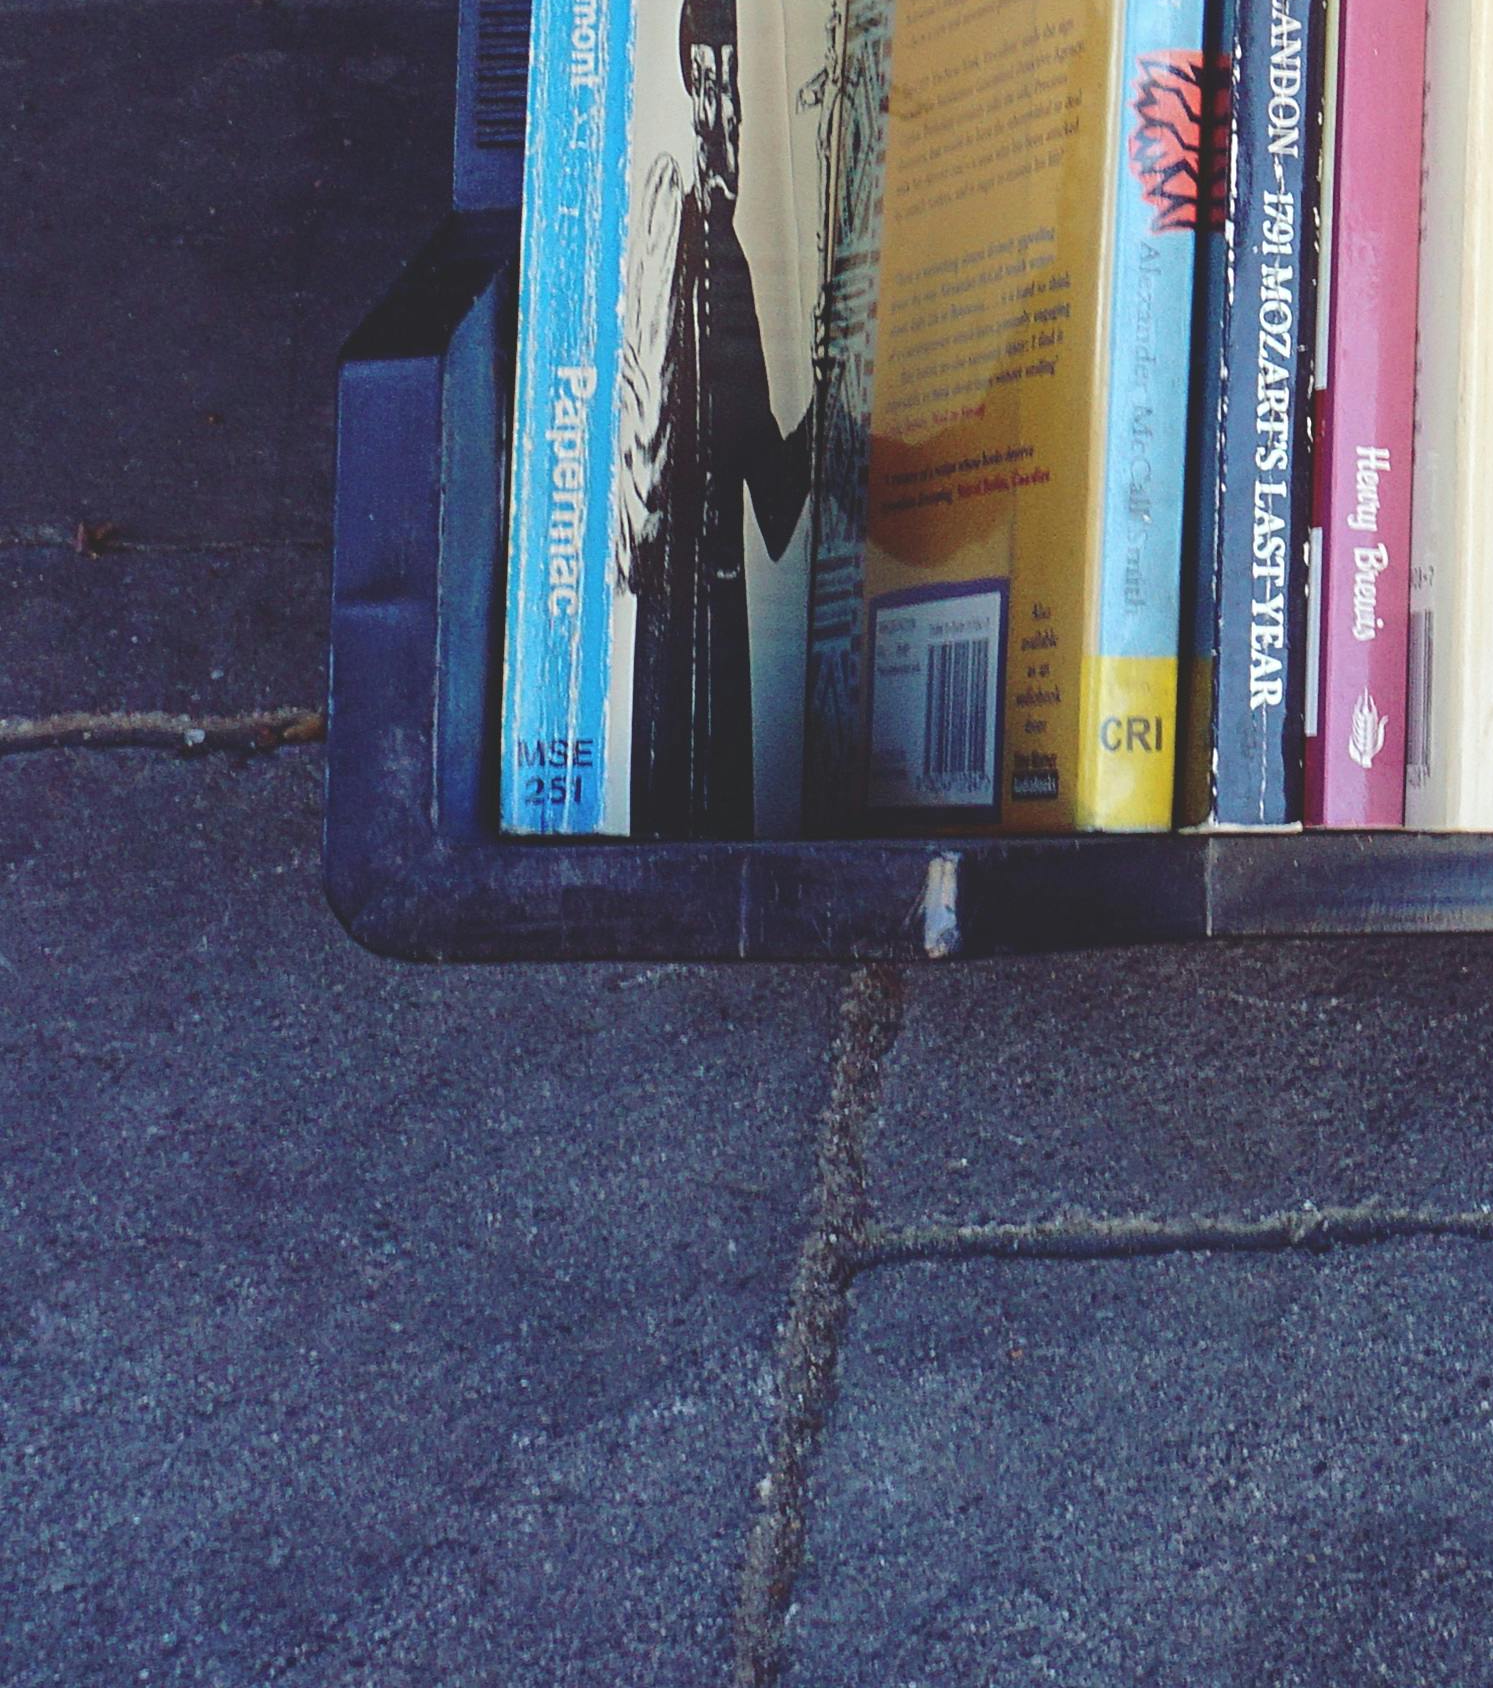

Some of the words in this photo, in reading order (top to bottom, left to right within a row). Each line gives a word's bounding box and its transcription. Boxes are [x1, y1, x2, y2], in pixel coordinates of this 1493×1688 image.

[1261, 191, 1293, 255] 1791
[1134, 242, 1161, 394] Alexander
[1255, 264, 1293, 471] MOZART'S
[546, 365, 597, 617] Papermac
[1128, 405, 1153, 521] McCall
[1348, 445, 1391, 532] Henry
[1125, 530, 1147, 614] Smith
[1252, 483, 1287, 582] LAST
[1353, 542, 1388, 642] Brewis
[1249, 599, 1286, 711] YEAR
[517, 739, 594, 769] MSE
[1100, 716, 1163, 753] CRI
[525, 776, 583, 806] 251
